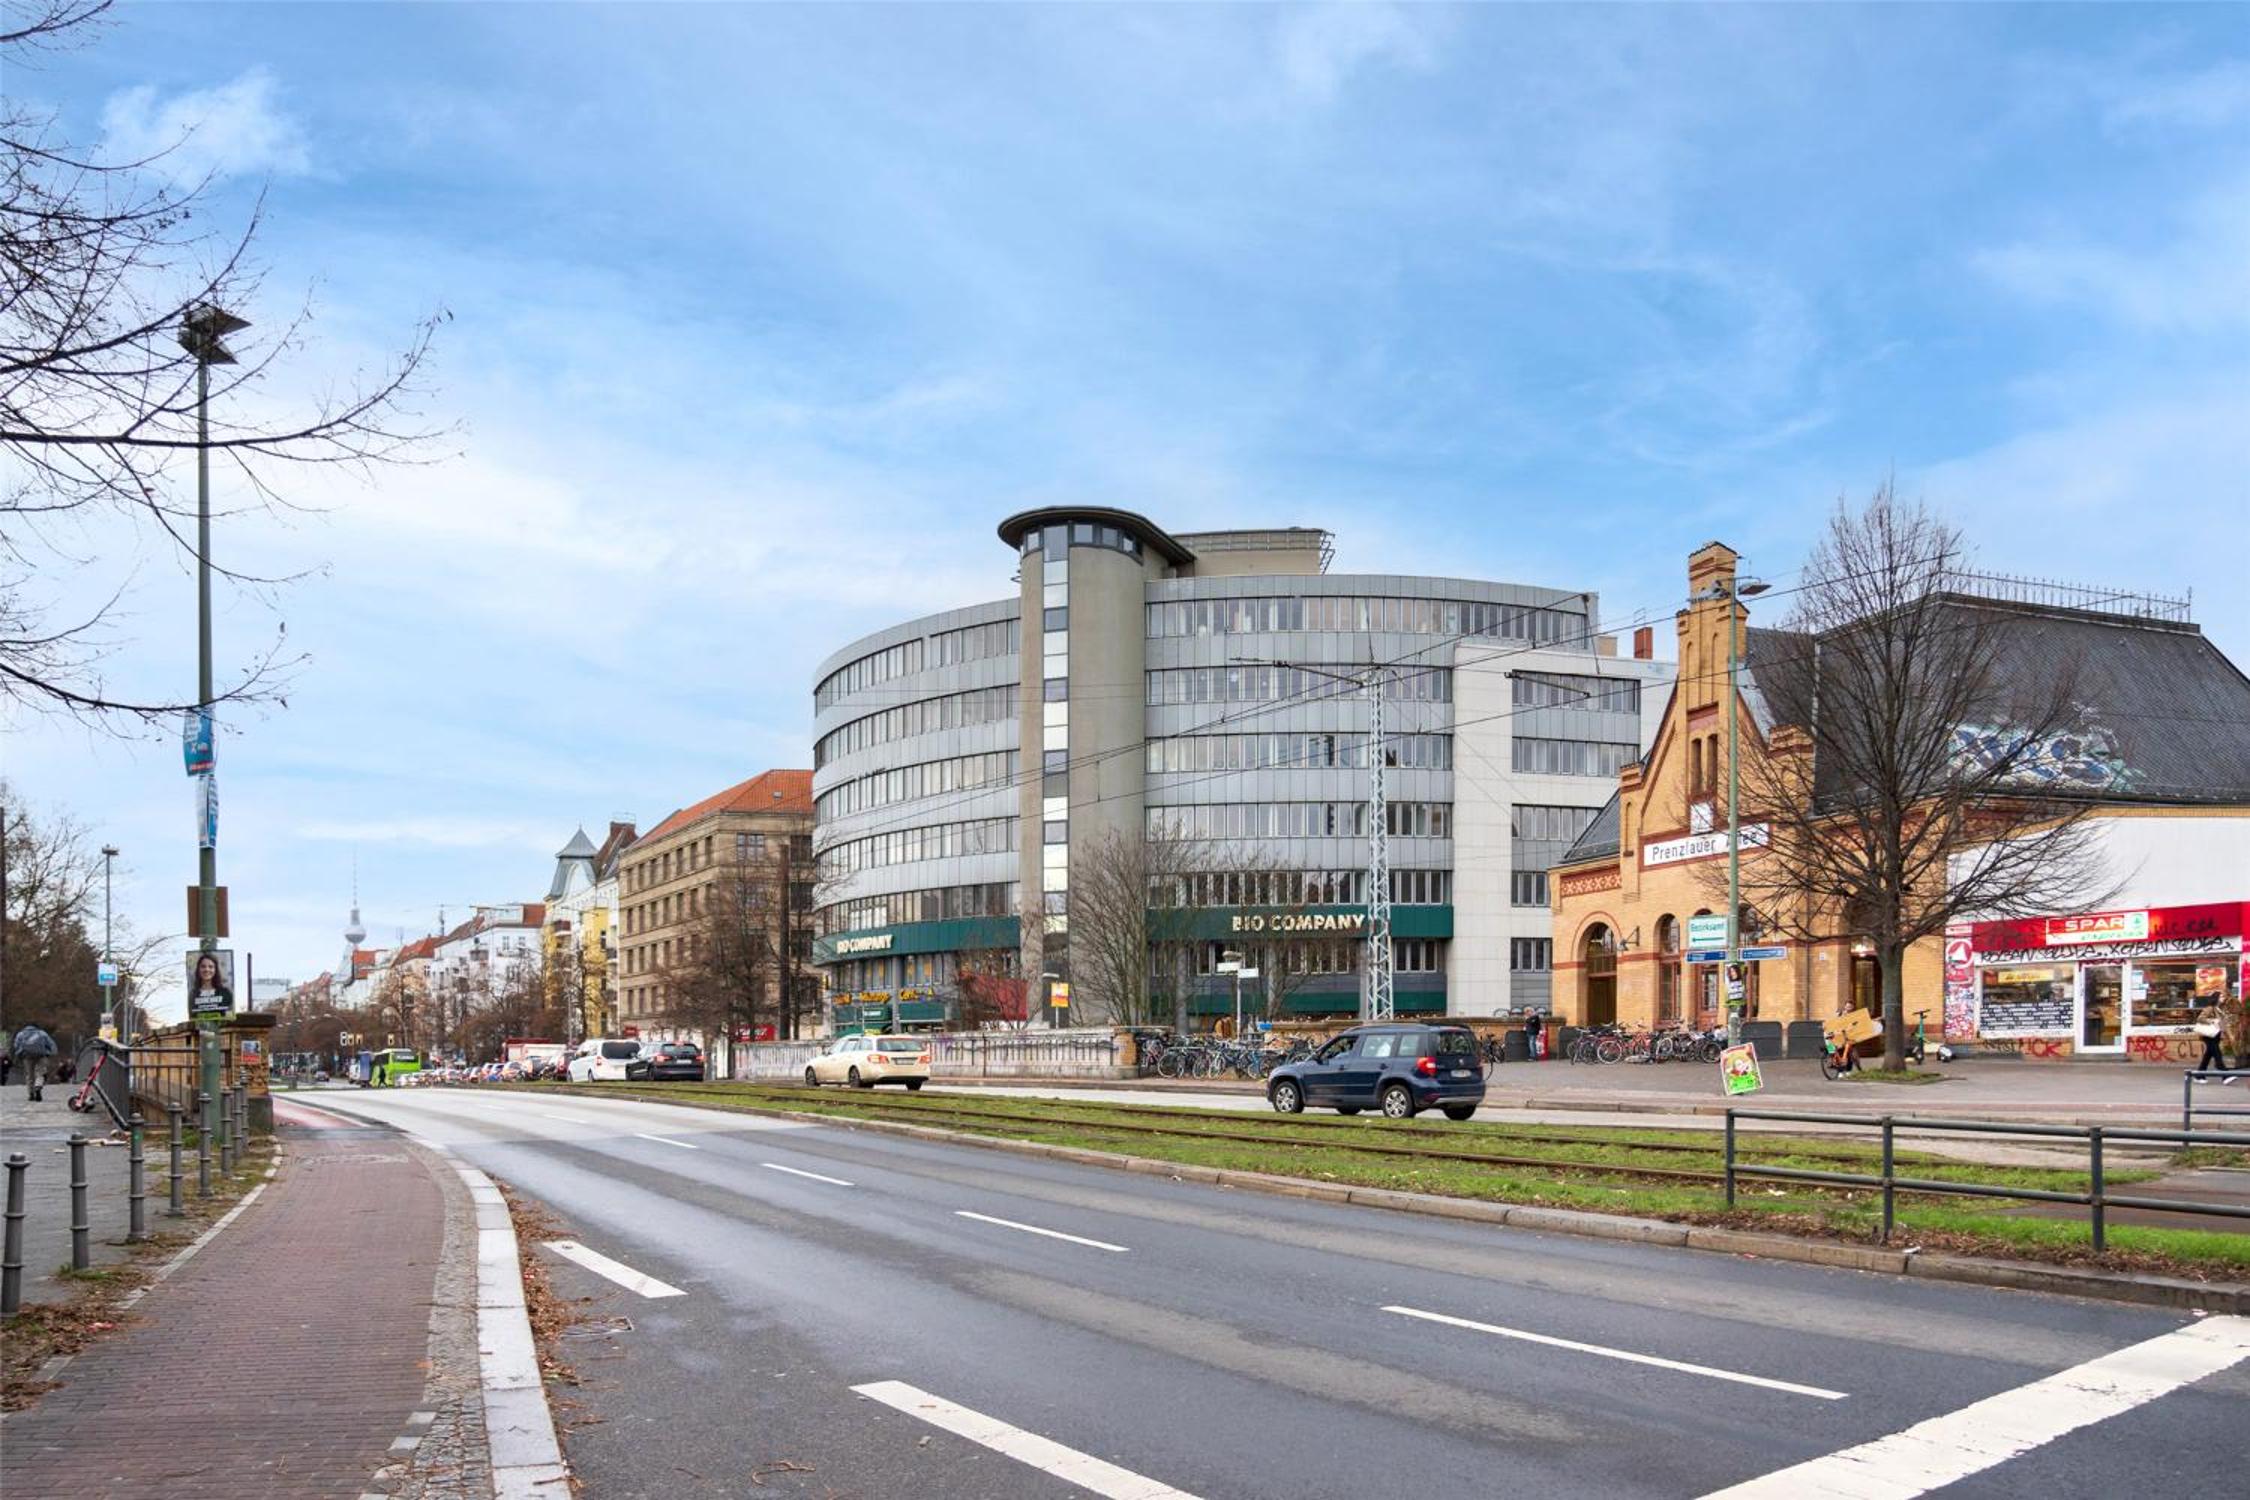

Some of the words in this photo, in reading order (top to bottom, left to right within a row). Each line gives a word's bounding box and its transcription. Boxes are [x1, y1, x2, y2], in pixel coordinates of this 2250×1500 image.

[1652, 839, 1716, 861] Prenzlauer
[1232, 915, 1265, 931] BIO
[1270, 913, 1365, 931] COMPANY
[2065, 917, 2125, 932] SPAR
[850, 934, 893, 952] COMPANY
